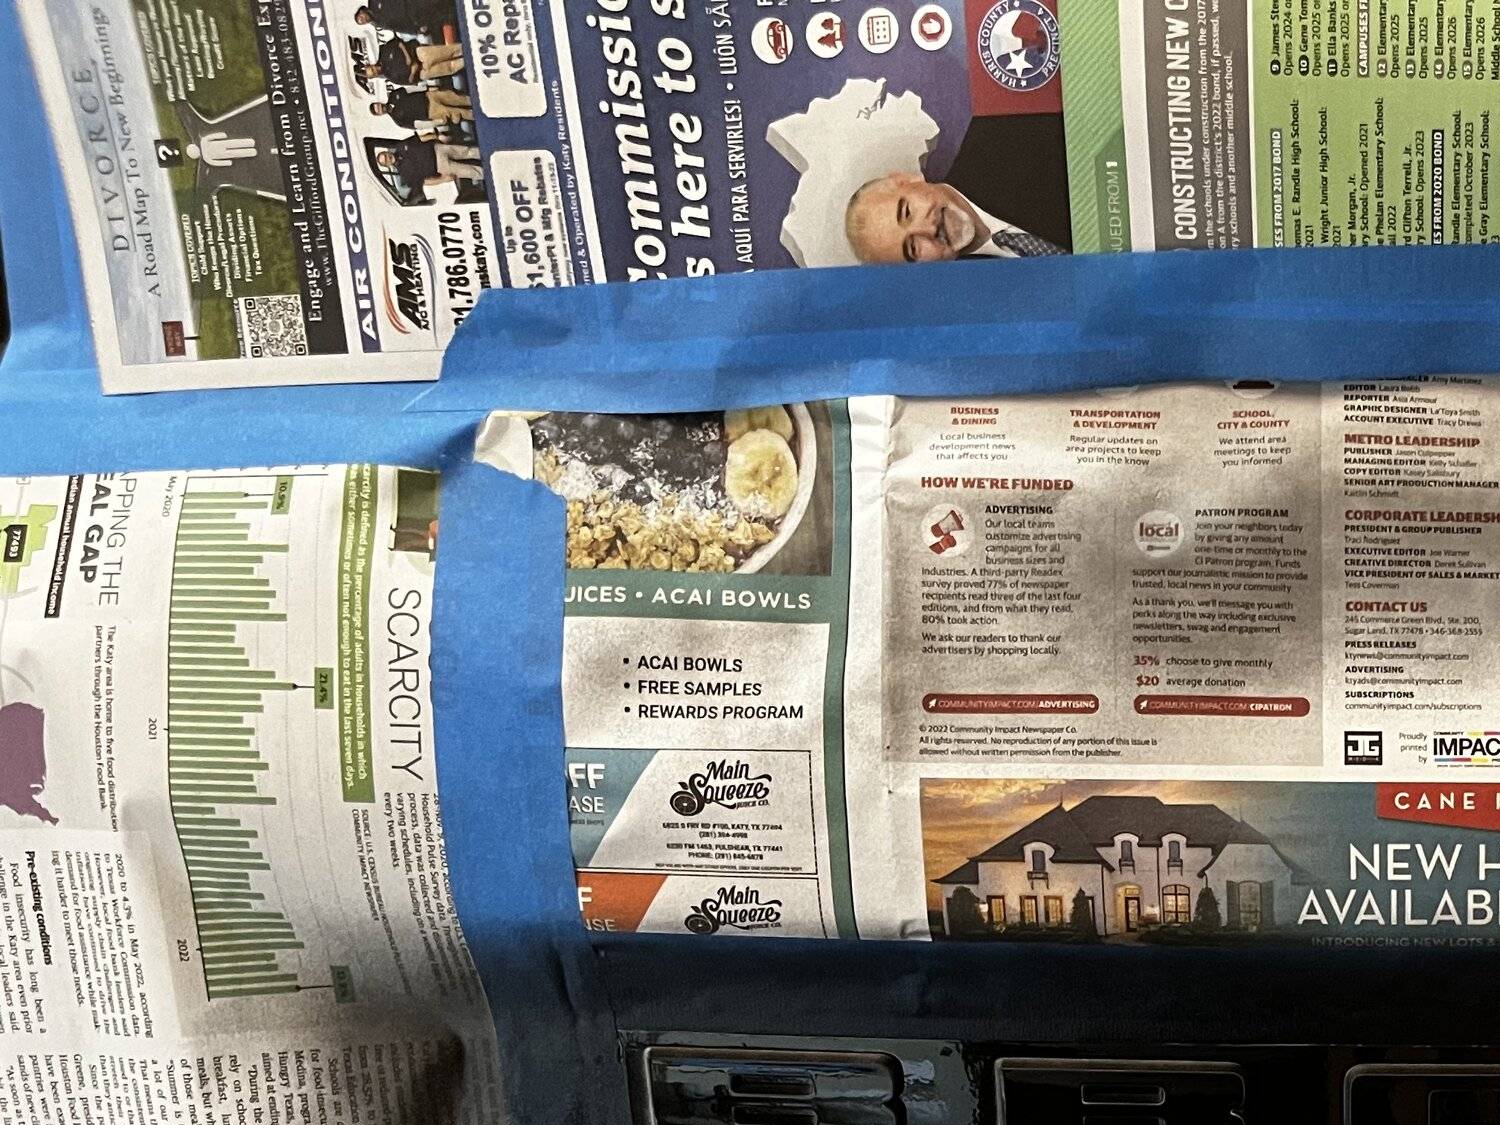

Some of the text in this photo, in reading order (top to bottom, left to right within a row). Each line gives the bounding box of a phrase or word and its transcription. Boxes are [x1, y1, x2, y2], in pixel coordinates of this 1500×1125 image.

[1390, 14, 1402, 79] Opens 2025
[652, 36, 712, 240] here to
[1165, 20, 1198, 241] CONSTRUCTING NEW
[266, 33, 323, 322] Engage and Learn from Divorce
[724, 99, 755, 263] AQUÍ PARA SERVIRLES!
[921, 477, 958, 489] HOW
[1012, 478, 1074, 490] FUNDED
[985, 505, 1054, 515] ADVERTISING
[652, 587, 812, 610] ACAI BOWLS
[637, 656, 743, 673] ACAI BOWLS
[387, 587, 423, 781] SCARCITY
[638, 680, 762, 696] FREE SAMPLES
[1136, 675, 1246, 688] $20 average donation
[1344, 690, 1415, 699] SUBSCRIPTIONS
[147, 716, 157, 741] 2021
[1394, 791, 1478, 810] CANE
[1349, 843, 1463, 881] NEW
